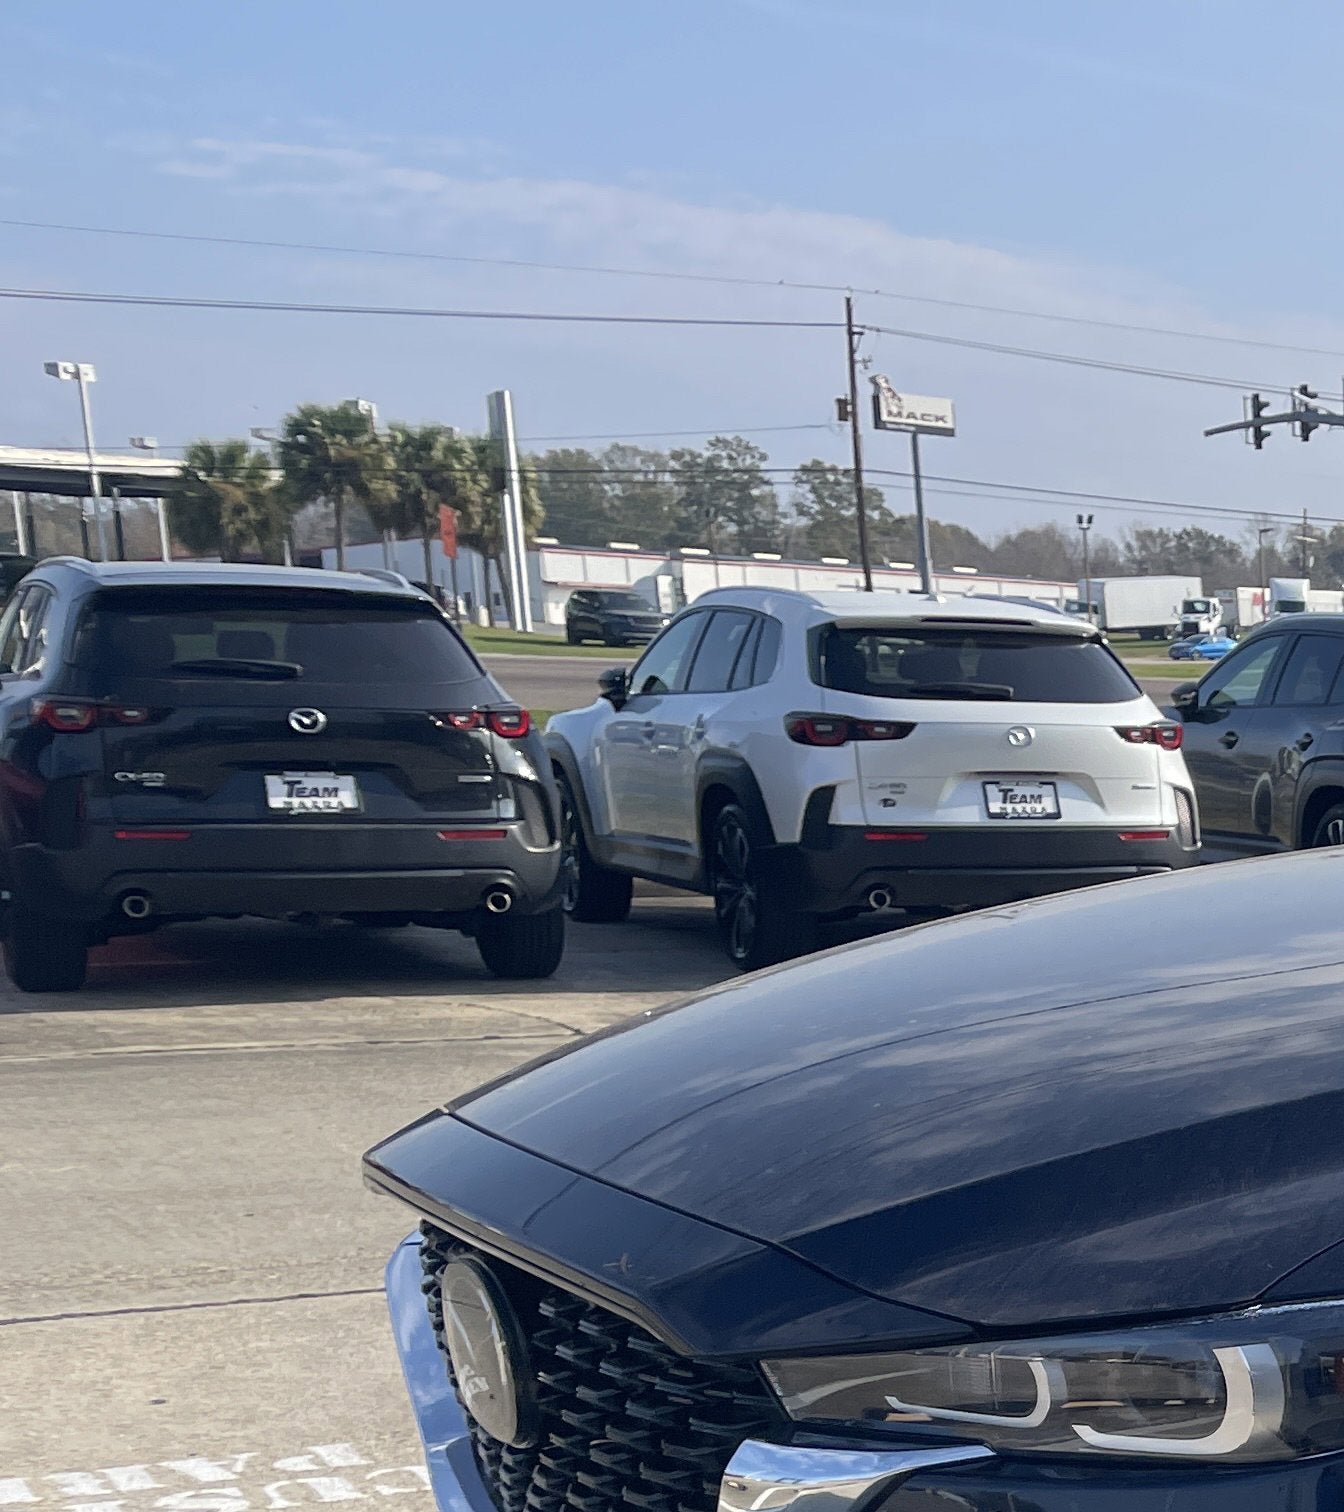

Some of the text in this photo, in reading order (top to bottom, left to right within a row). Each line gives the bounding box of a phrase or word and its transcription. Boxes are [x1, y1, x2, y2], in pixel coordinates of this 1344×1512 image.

[887, 409, 948, 424] MACK
[282, 779, 339, 798] TEAM
[998, 788, 1043, 805] TEAM
